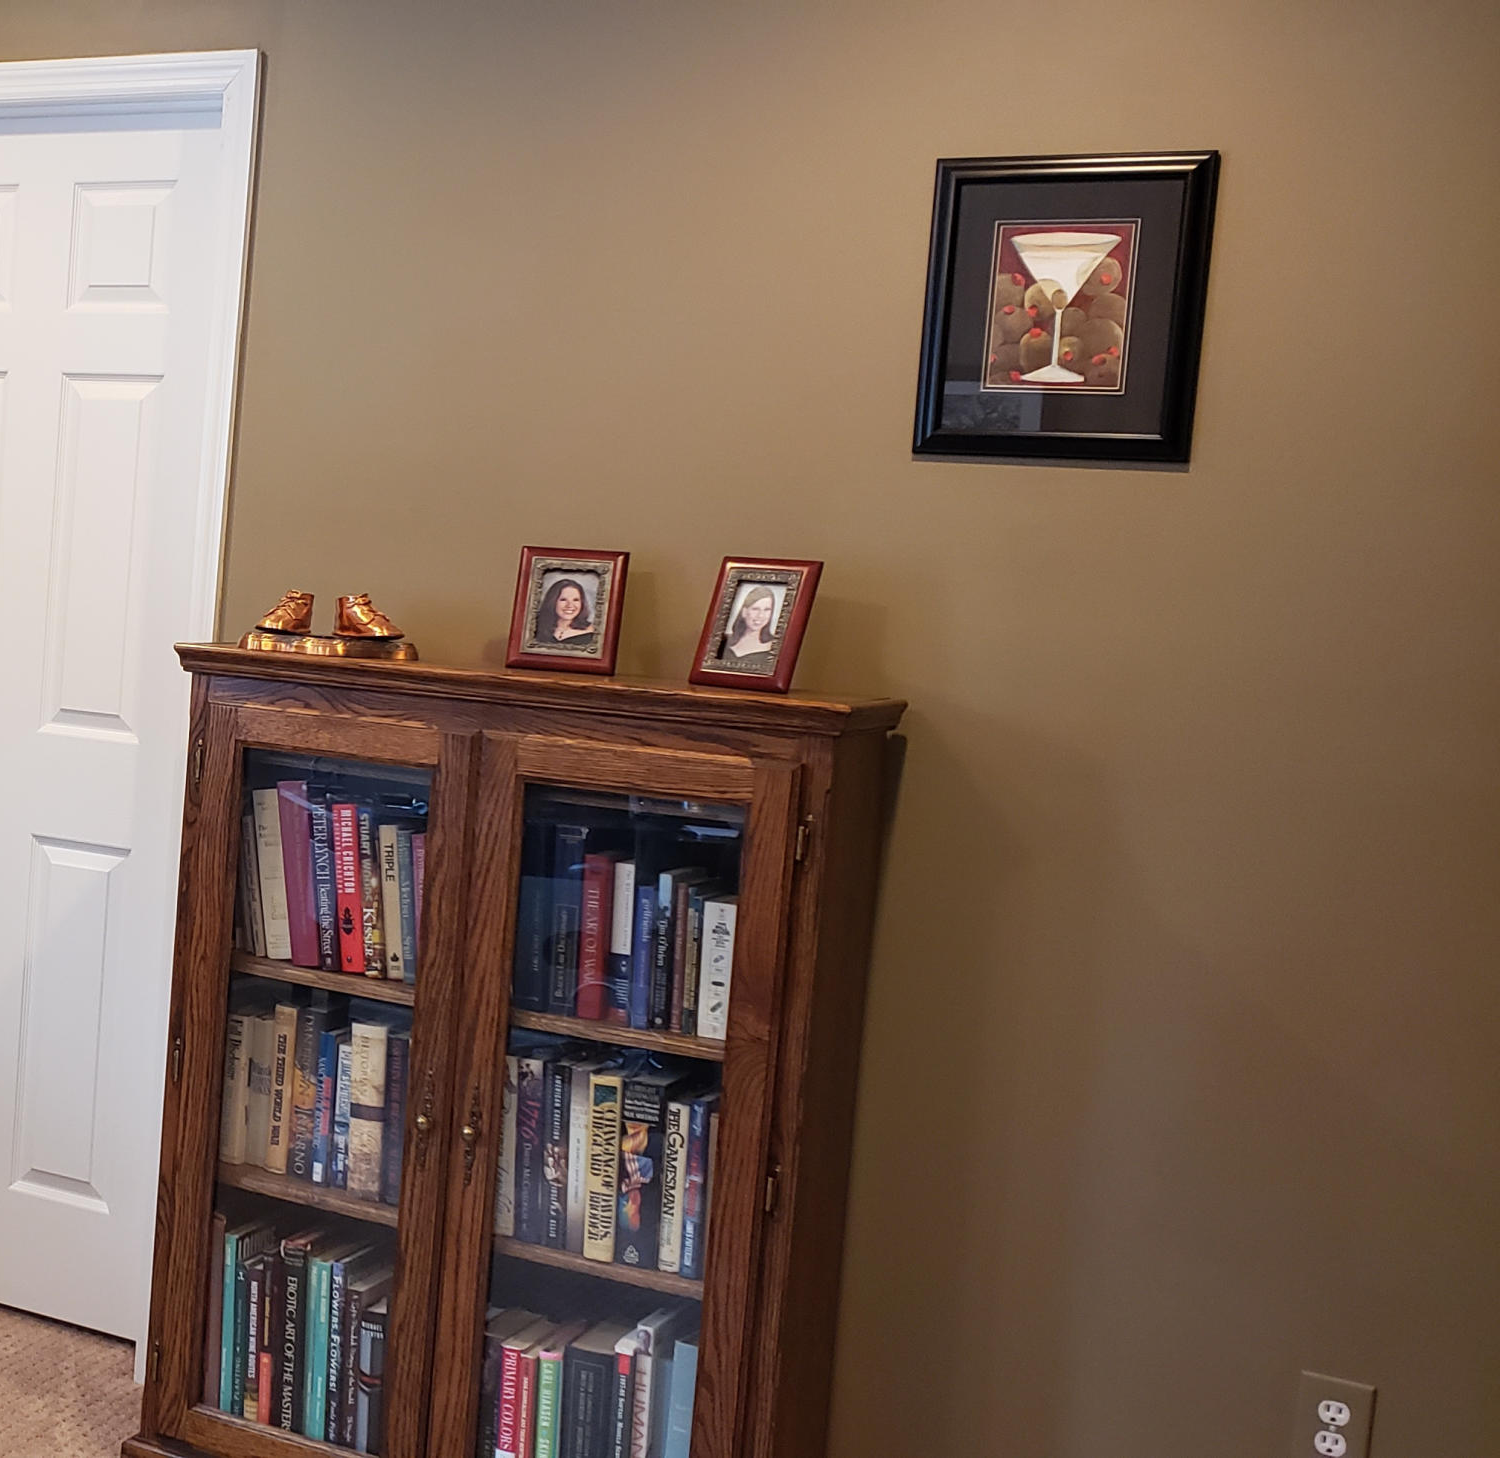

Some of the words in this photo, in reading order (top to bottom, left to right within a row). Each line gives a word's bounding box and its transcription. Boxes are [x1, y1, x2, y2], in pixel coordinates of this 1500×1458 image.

[312, 804, 328, 841] PETER
[340, 809, 354, 847] MICHAEL
[359, 813, 372, 855] STUART
[315, 842, 331, 879] LYNCH
[343, 851, 356, 894] CRICHTON
[384, 843, 395, 883] TRIPLE
[361, 858, 373, 902] WOODS
[586, 888, 599, 911] THE
[586, 915, 599, 936] ART
[641, 898, 653, 943] girlfriends
[585, 939, 598, 954] OF
[583, 958, 597, 984] WAR
[277, 1034, 286, 1055] THE
[275, 1057, 285, 1086] THIRD
[359, 1035, 372, 1098] HISTORIAN
[273, 1089, 282, 1122] WORLD
[520, 1100, 541, 1144] 1776
[591, 1108, 605, 1130] THE
[668, 1108, 681, 1131] THE
[270, 1125, 280, 1146] WAR
[293, 1105, 312, 1174] INFERNO
[602, 1109, 618, 1174] CHANGING
[663, 1132, 685, 1217] GAMESMAN
[600, 1192, 614, 1229] DAVID
[249, 1281, 258, 1302] NORTH
[286, 1276, 298, 1318] EROTIC
[248, 1303, 258, 1336] AMERICAN
[285, 1320, 296, 1341] ART
[247, 1337, 257, 1353] WINE
[284, 1343, 296, 1359] OF
[329, 1334, 342, 1392] FLOWERS!
[247, 1354, 257, 1379] ROUTES
[283, 1362, 295, 1383] THE
[502, 1350, 518, 1402] PRIMARY
[541, 1363, 554, 1386] CARL
[500, 1403, 516, 1450] COLORS
[540, 1390, 552, 1427] HIAASEN
